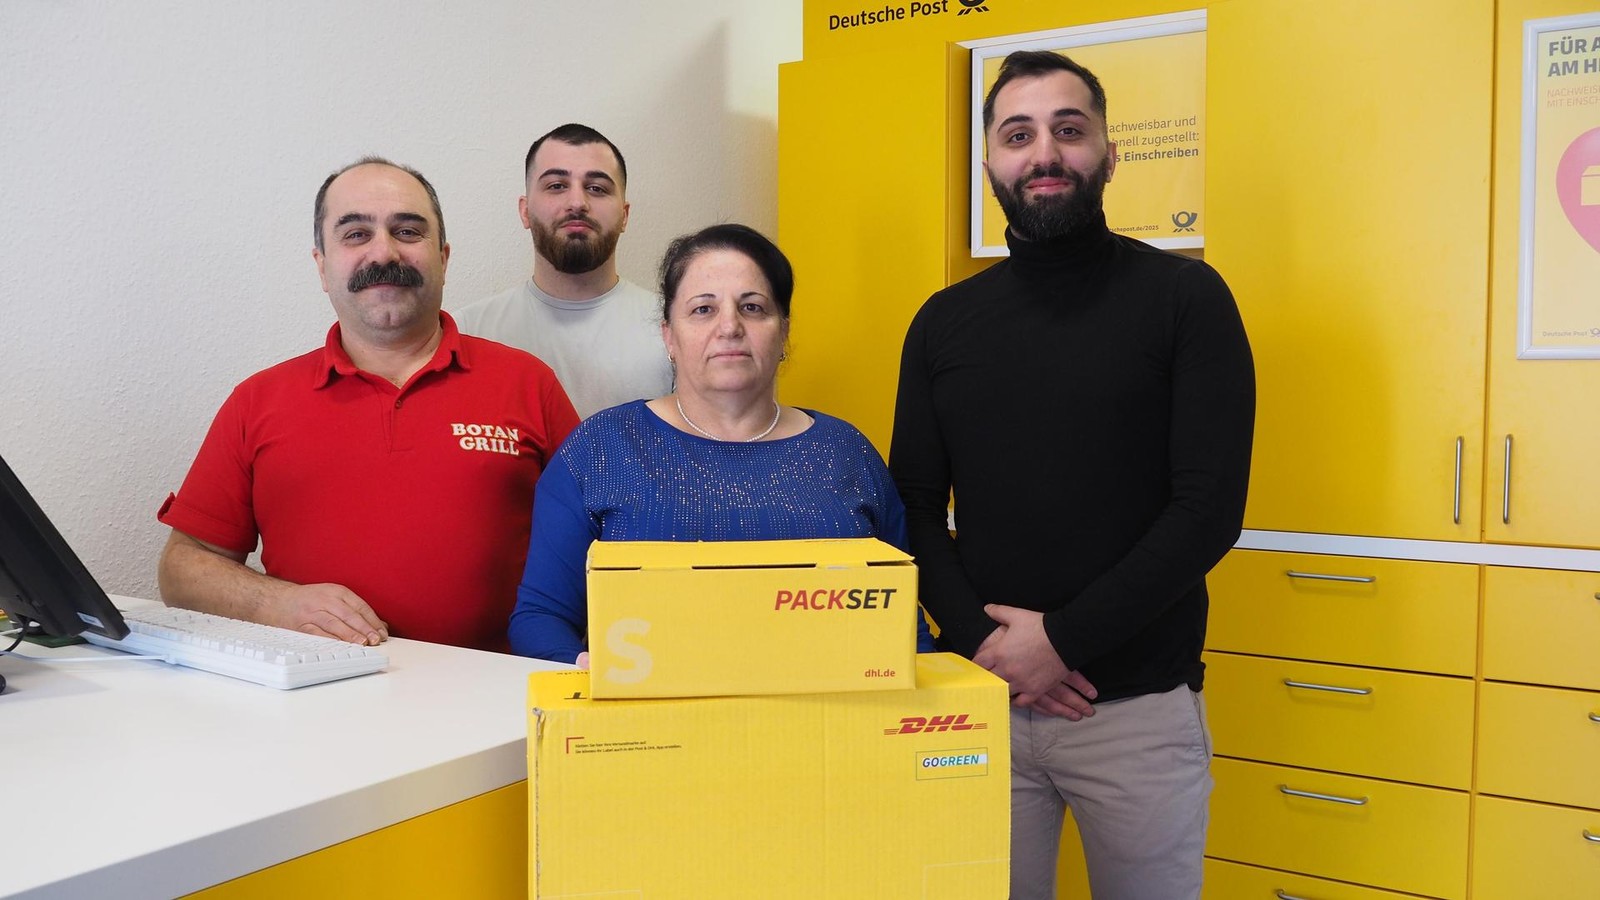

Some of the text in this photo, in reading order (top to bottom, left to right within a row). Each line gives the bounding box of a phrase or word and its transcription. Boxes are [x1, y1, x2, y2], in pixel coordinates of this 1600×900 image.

[829, 0, 948, 31] Deutsche Post
[1549, 36, 1587, 56] FÜR
[1548, 60, 1579, 77] AM
[1547, 84, 1600, 98] NACHWEIS
[1547, 95, 1600, 109] MIT EINSCH
[1107, 115, 1196, 133] achweisbar und
[1141, 131, 1199, 147] zugestellt:
[1124, 147, 1199, 162] Einschreiben
[450, 423, 519, 442] BOTAN
[459, 436, 520, 456] GRILL
[774, 588, 897, 611] PACKSET
[602, 617, 654, 685] S
[864, 668, 896, 678] dhl.de
[897, 713, 975, 735] DHL
[922, 754, 980, 768] GOGREEN
